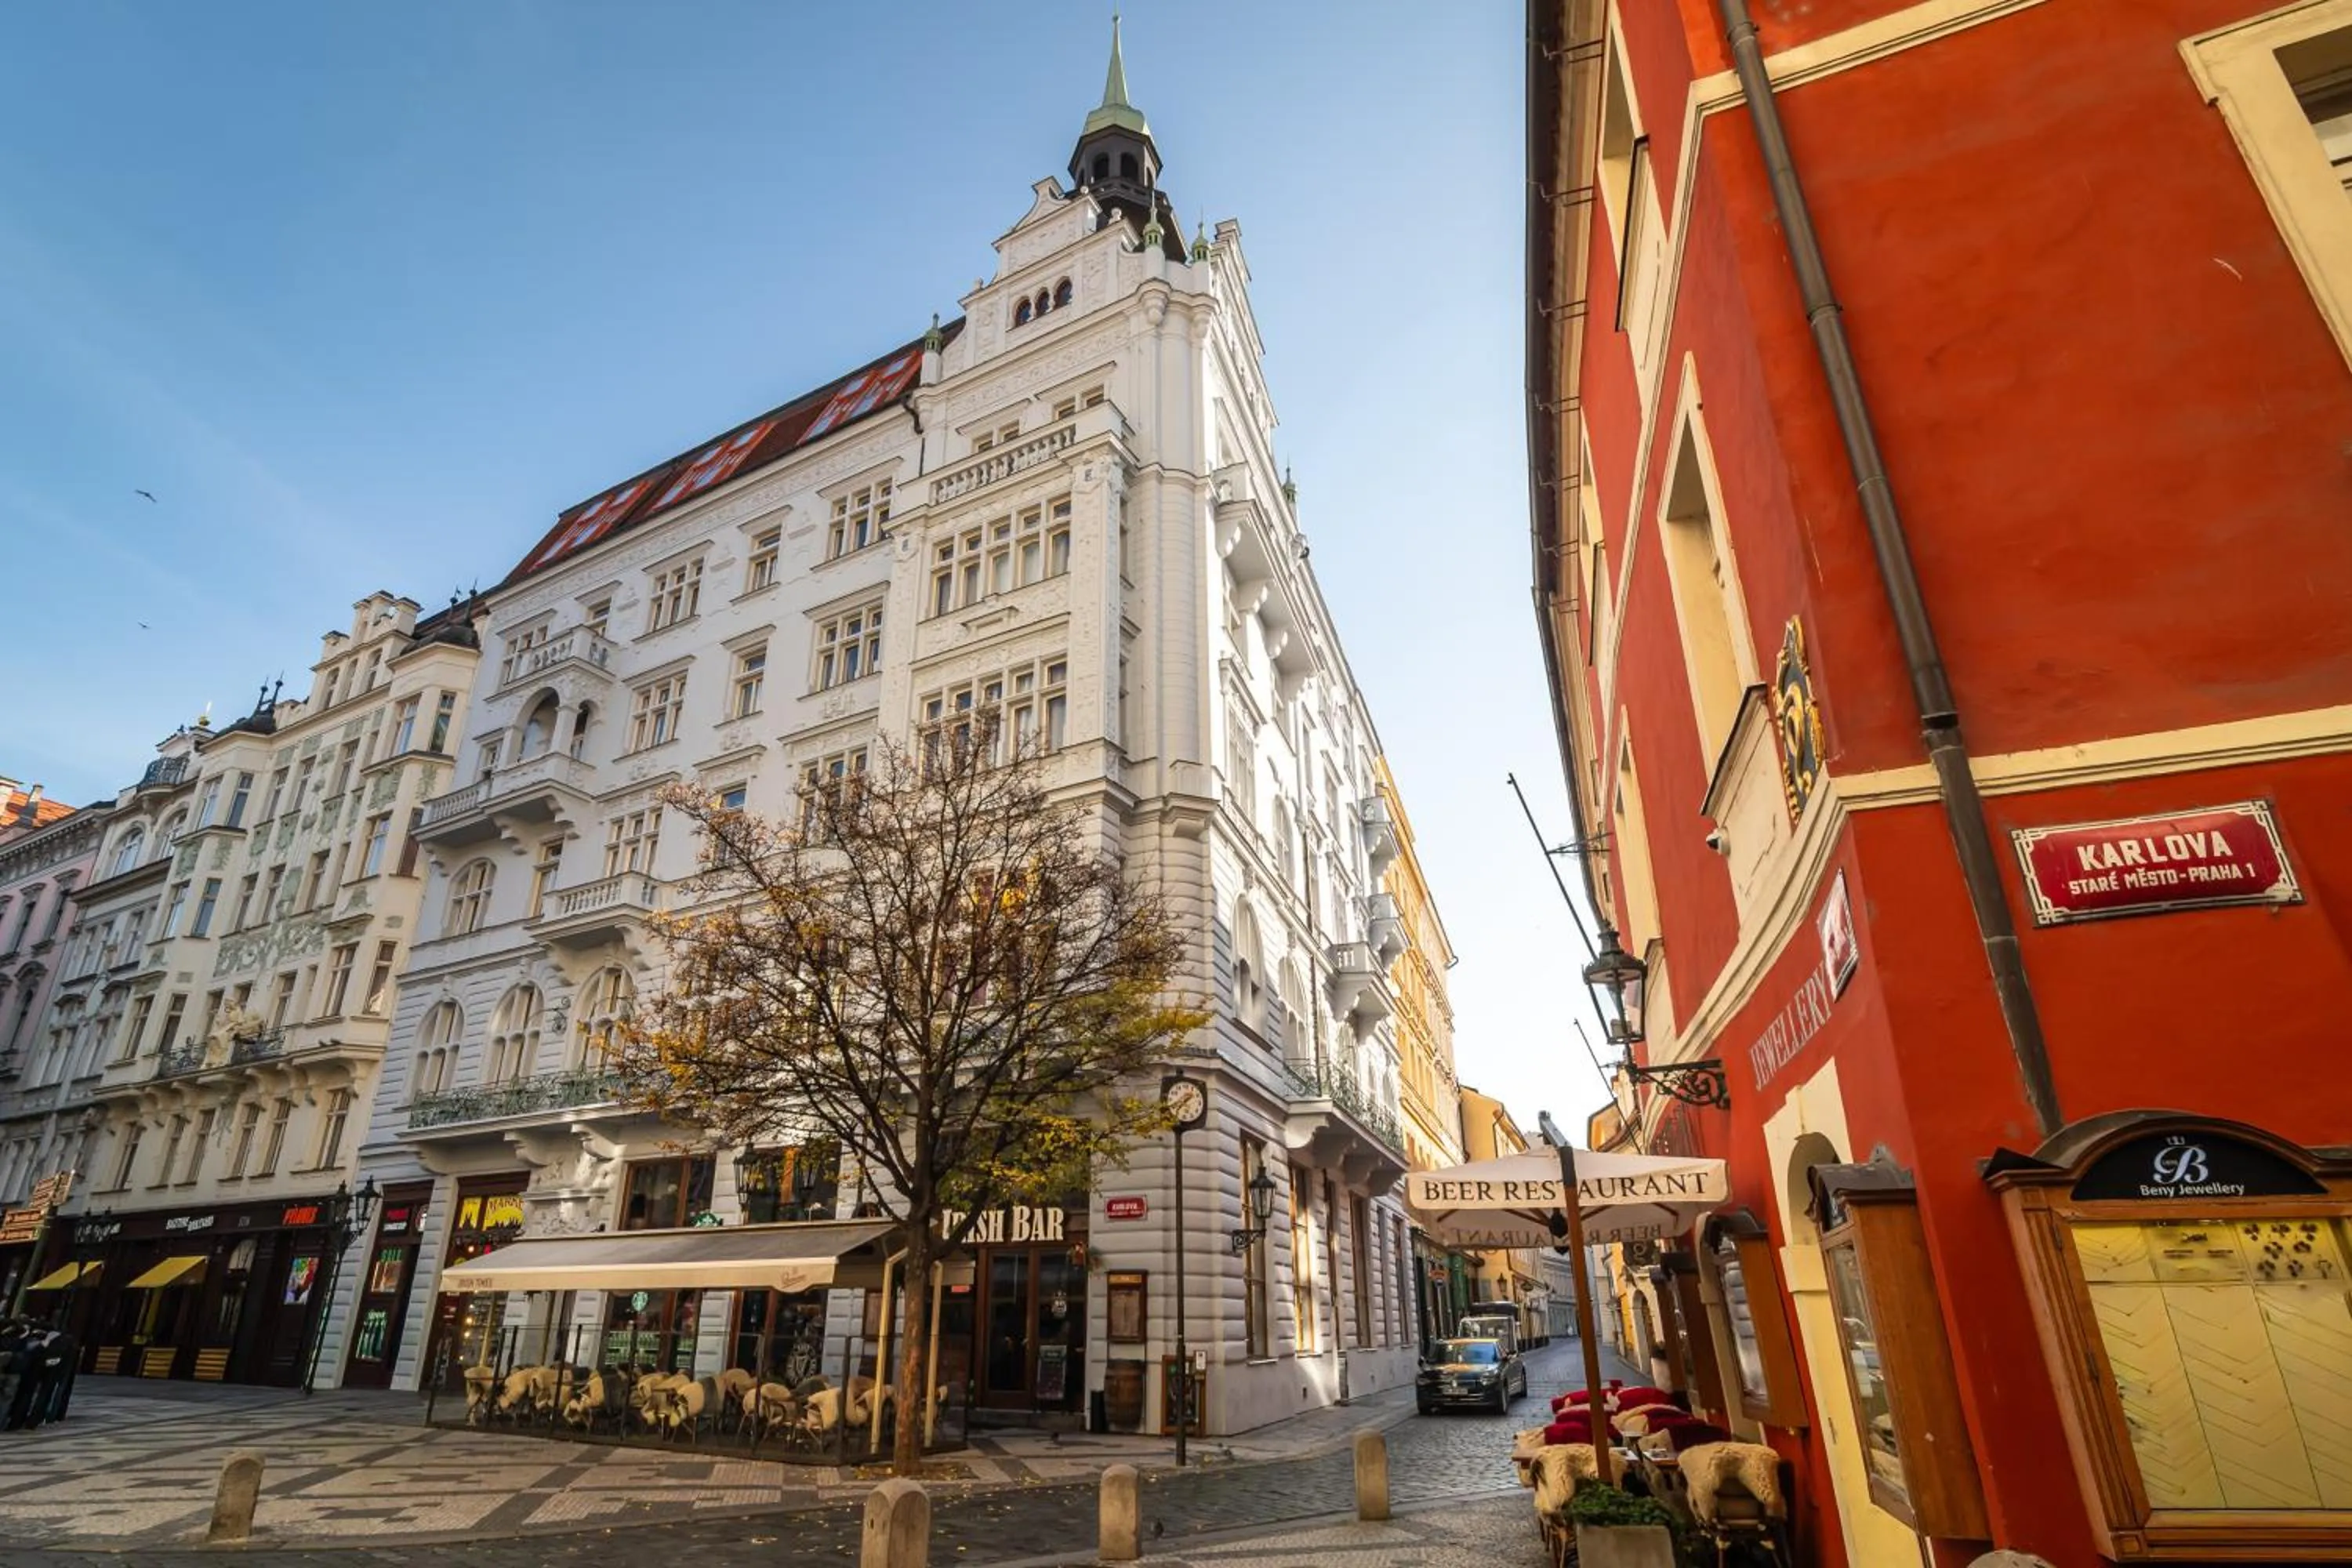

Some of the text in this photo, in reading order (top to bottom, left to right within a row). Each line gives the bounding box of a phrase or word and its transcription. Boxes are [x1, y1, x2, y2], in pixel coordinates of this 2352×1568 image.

[2077, 830, 2233, 871] KARLOVA
[2068, 871, 2119, 895] STARÉ
[2246, 863, 2256, 877] 1
[1750, 963, 1831, 1091] JEWELLERY
[1424, 1181, 1494, 1200] BEER
[2140, 1182, 2245, 1198] Beny Jewellery
[1011, 1206, 1064, 1241] BAR
